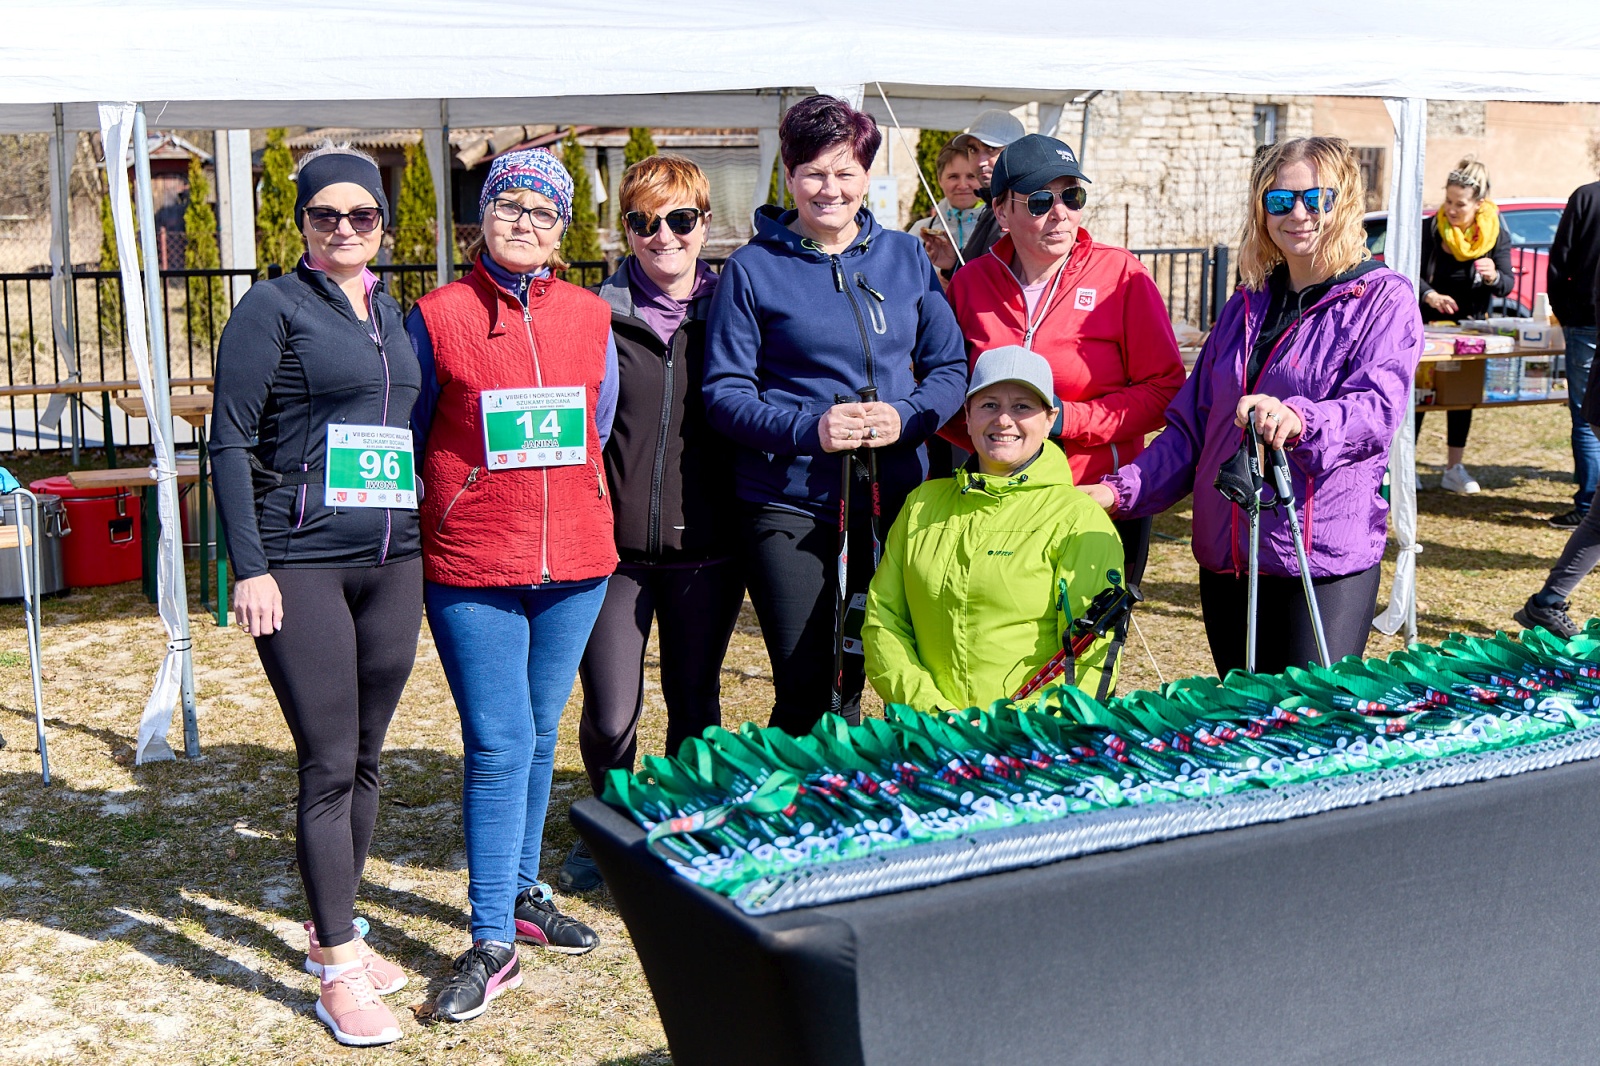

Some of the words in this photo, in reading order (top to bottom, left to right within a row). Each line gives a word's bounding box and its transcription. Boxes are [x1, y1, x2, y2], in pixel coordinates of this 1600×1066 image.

[516, 410, 561, 438] 14
[522, 439, 559, 449] JANINA
[359, 450, 400, 479] 96
[366, 480, 398, 489] IWONA
